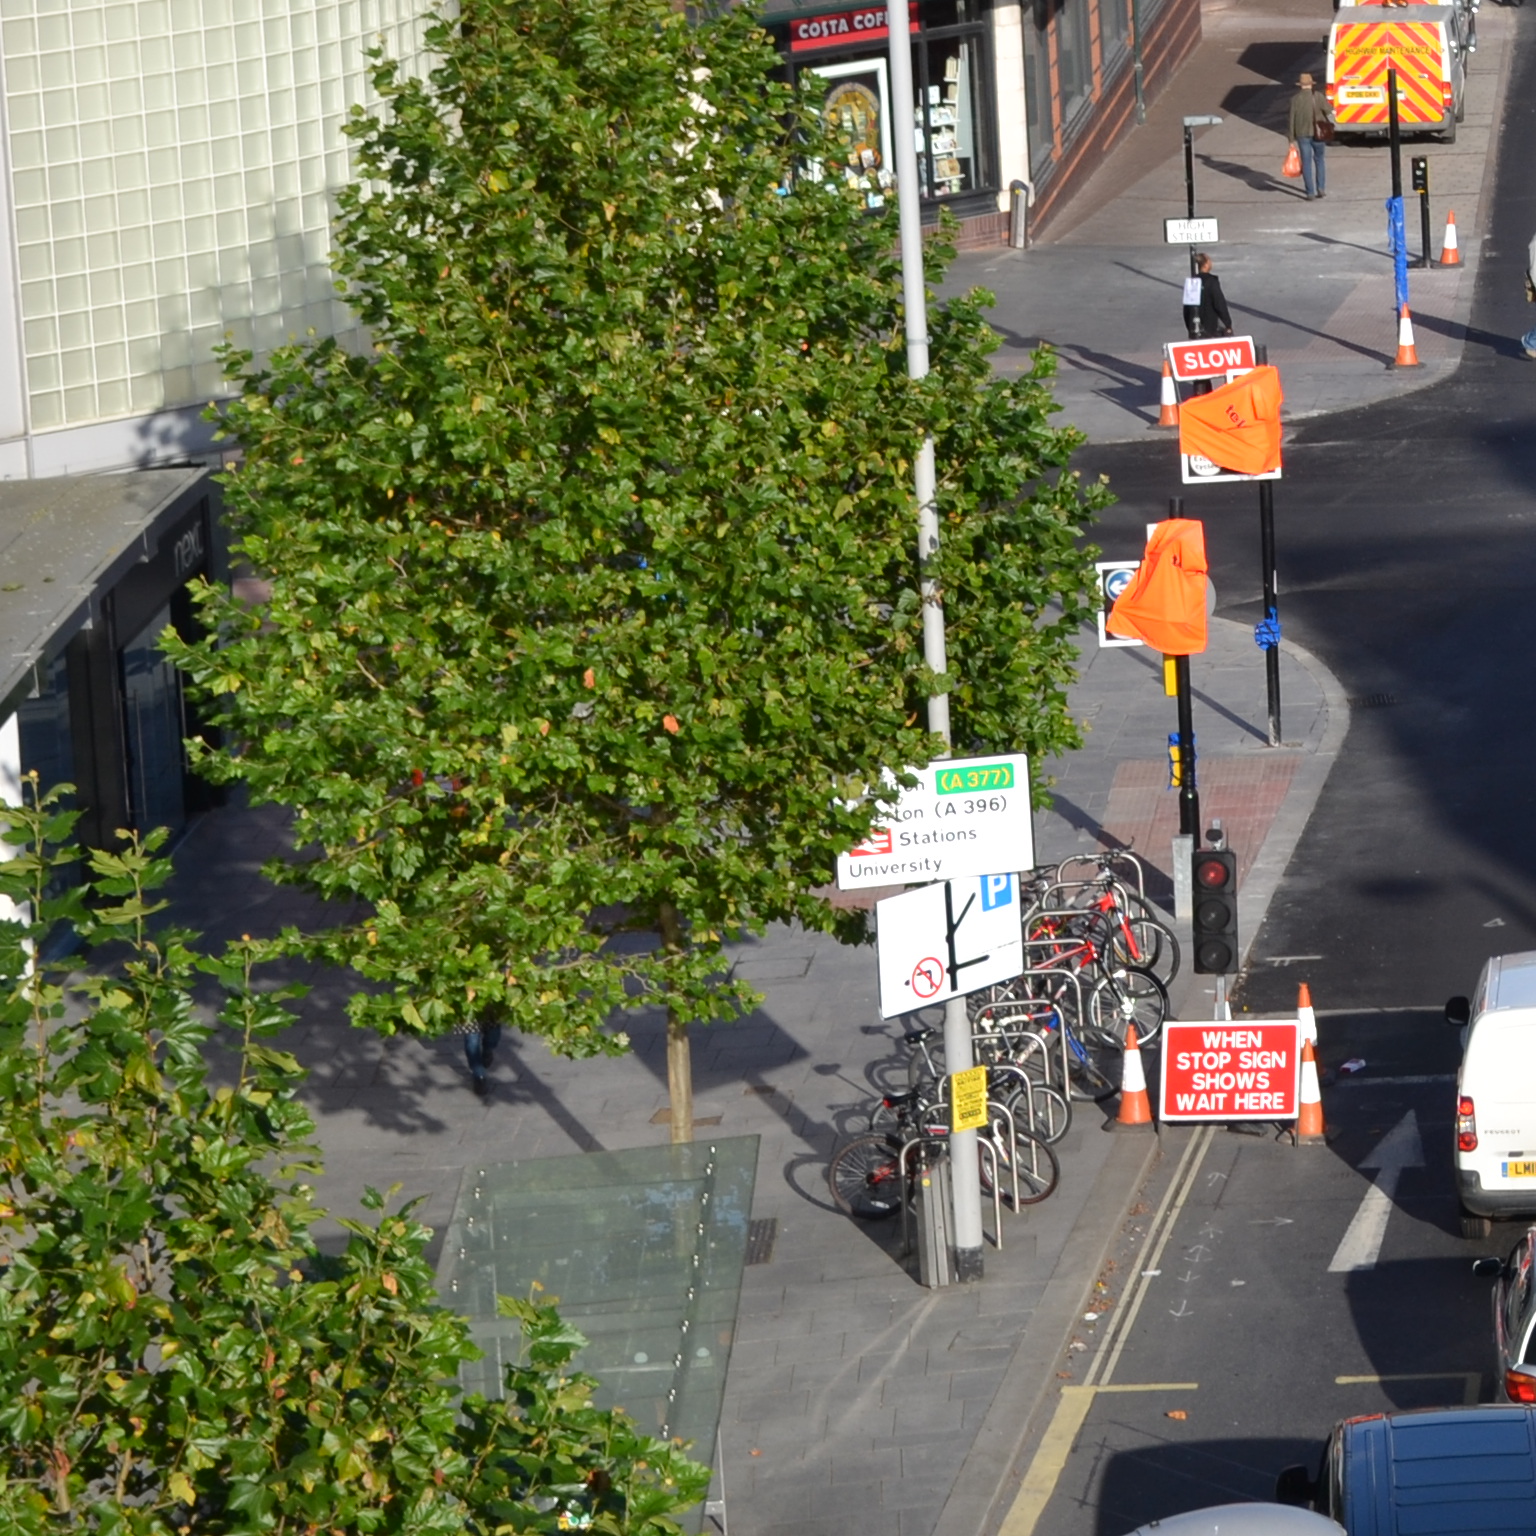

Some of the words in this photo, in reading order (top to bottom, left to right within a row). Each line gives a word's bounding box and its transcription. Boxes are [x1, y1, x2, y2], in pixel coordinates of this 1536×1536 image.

[798, 18, 849, 39] COSTA
[853, 11, 889, 30] COF
[1345, 47, 1377, 55] HIGHWAY
[1379, 47, 1431, 55] MAINTENANCE
[1178, 221, 1205, 230] HIGH
[1172, 232, 1212, 242] STREET
[1183, 348, 1242, 370] SLOW
[174, 521, 204, 578] next
[900, 828, 977, 846] Stations
[849, 858, 942, 878] University
[1202, 1031, 1262, 1049] WHEN
[1176, 1051, 1231, 1070] STOP
[1239, 1051, 1286, 1069] SIGN
[1192, 1071, 1270, 1090] SHOWS
[1176, 1093, 1228, 1111] WAIT
[1234, 1092, 1285, 1110] HERE
